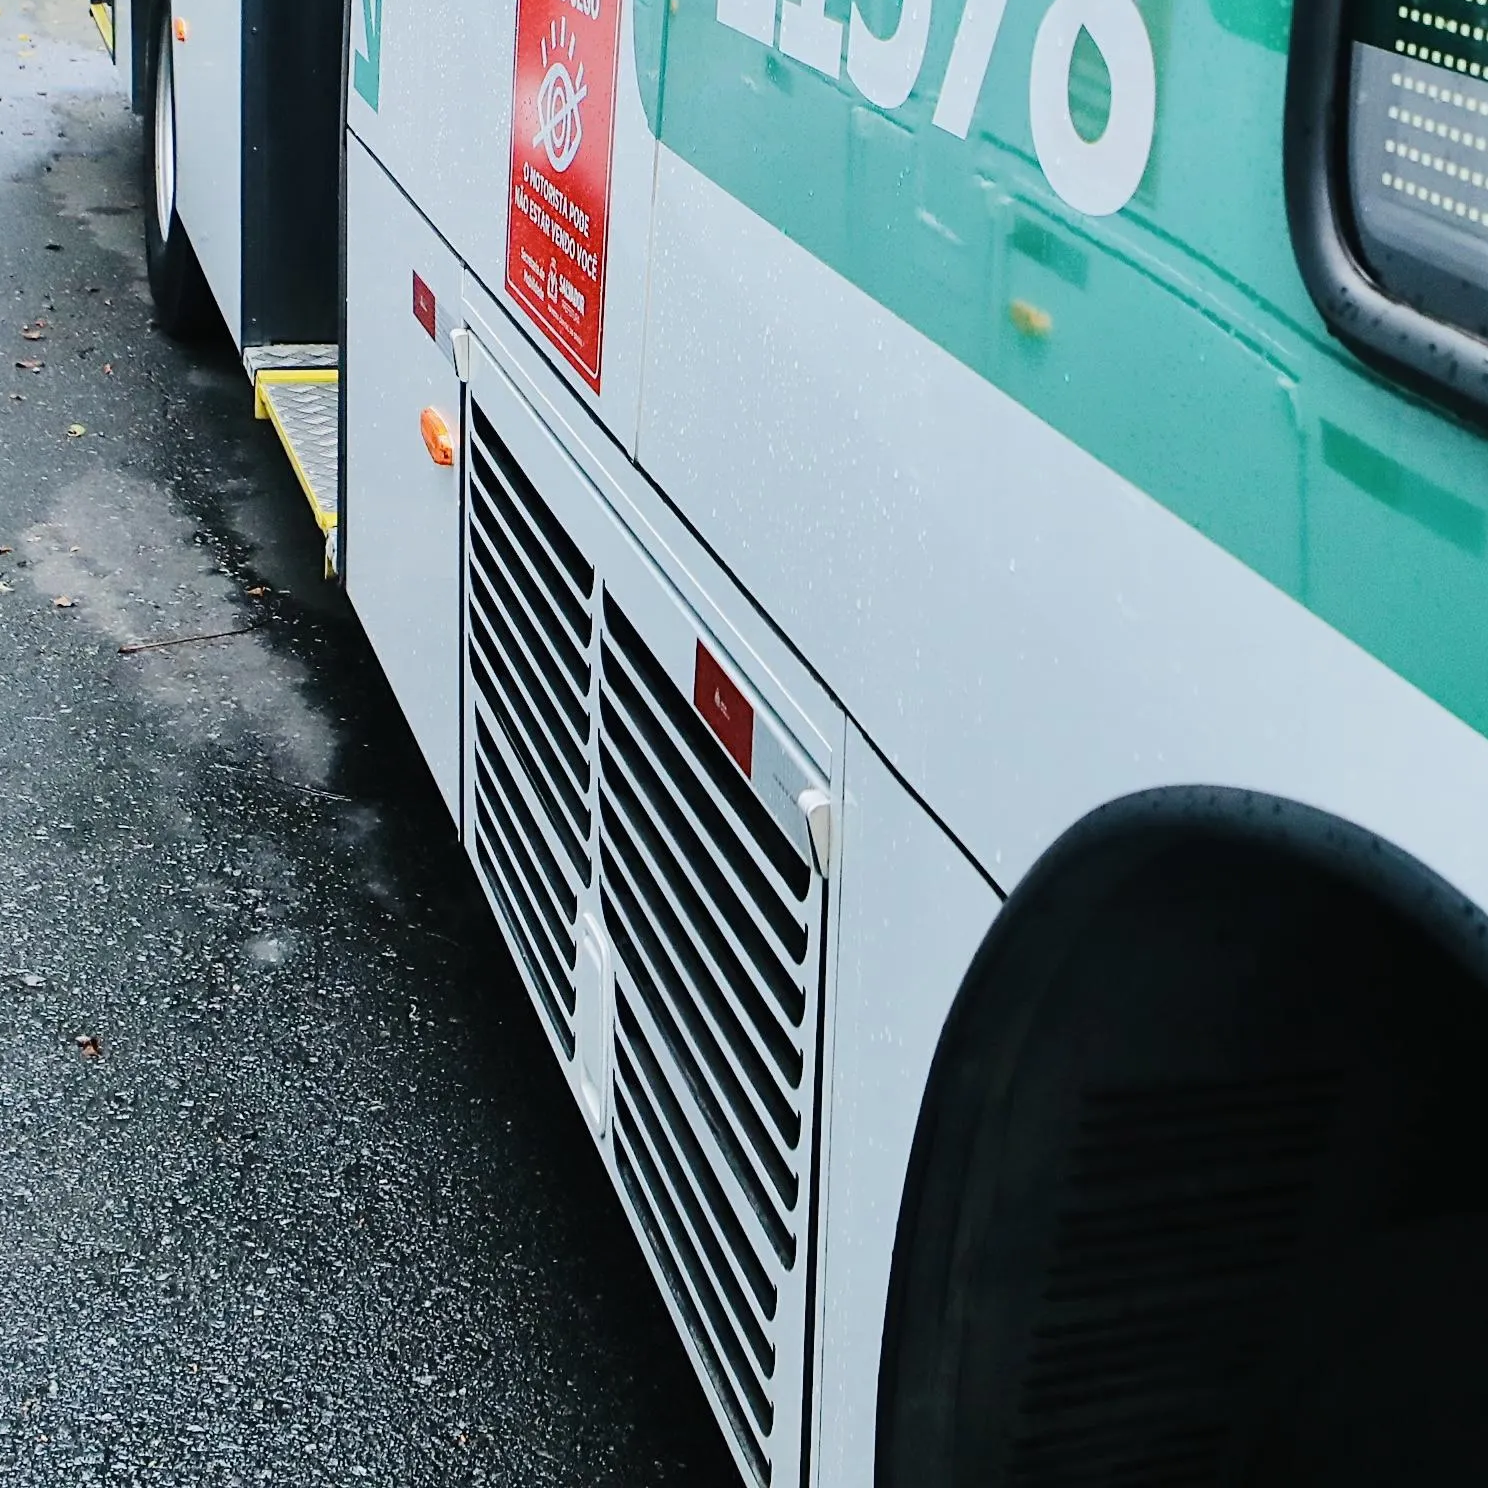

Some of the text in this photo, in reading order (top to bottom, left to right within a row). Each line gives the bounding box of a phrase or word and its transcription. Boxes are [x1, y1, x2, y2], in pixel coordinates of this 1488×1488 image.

[515, 184, 598, 282] NÃO ESTAR VENDO VOCÊ
[523, 162, 591, 239] O MOTORISTA PODE
